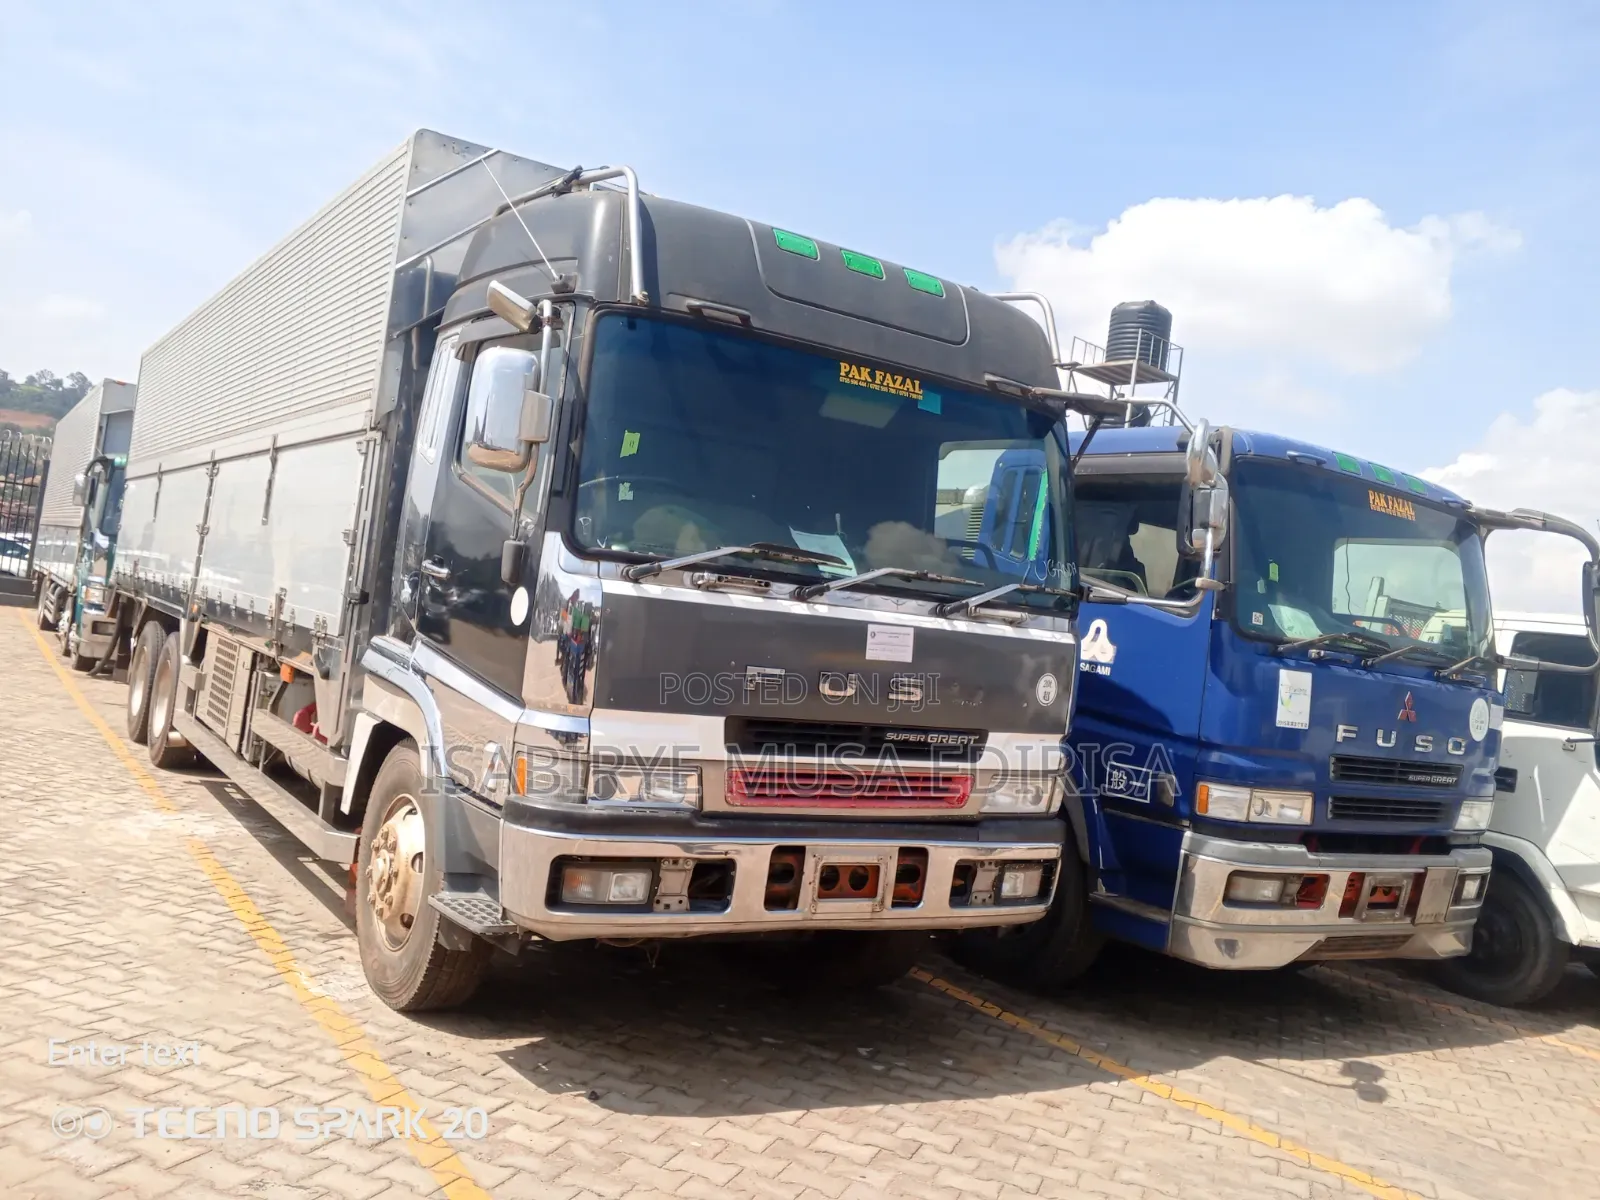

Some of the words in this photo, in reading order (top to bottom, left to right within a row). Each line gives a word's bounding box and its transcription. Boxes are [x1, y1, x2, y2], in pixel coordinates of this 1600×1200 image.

[839, 362, 872, 382] PAK
[874, 370, 923, 394] FAZAL
[1368, 489, 1387, 508] PAK
[1387, 495, 1415, 515] FAZAL
[1079, 662, 1111, 676] SAGAMI
[885, 732, 926, 742] SUPER
[928, 733, 979, 746] GREAT
[1336, 724, 1467, 755] FUSO
[1430, 775, 1458, 785] GREAT
